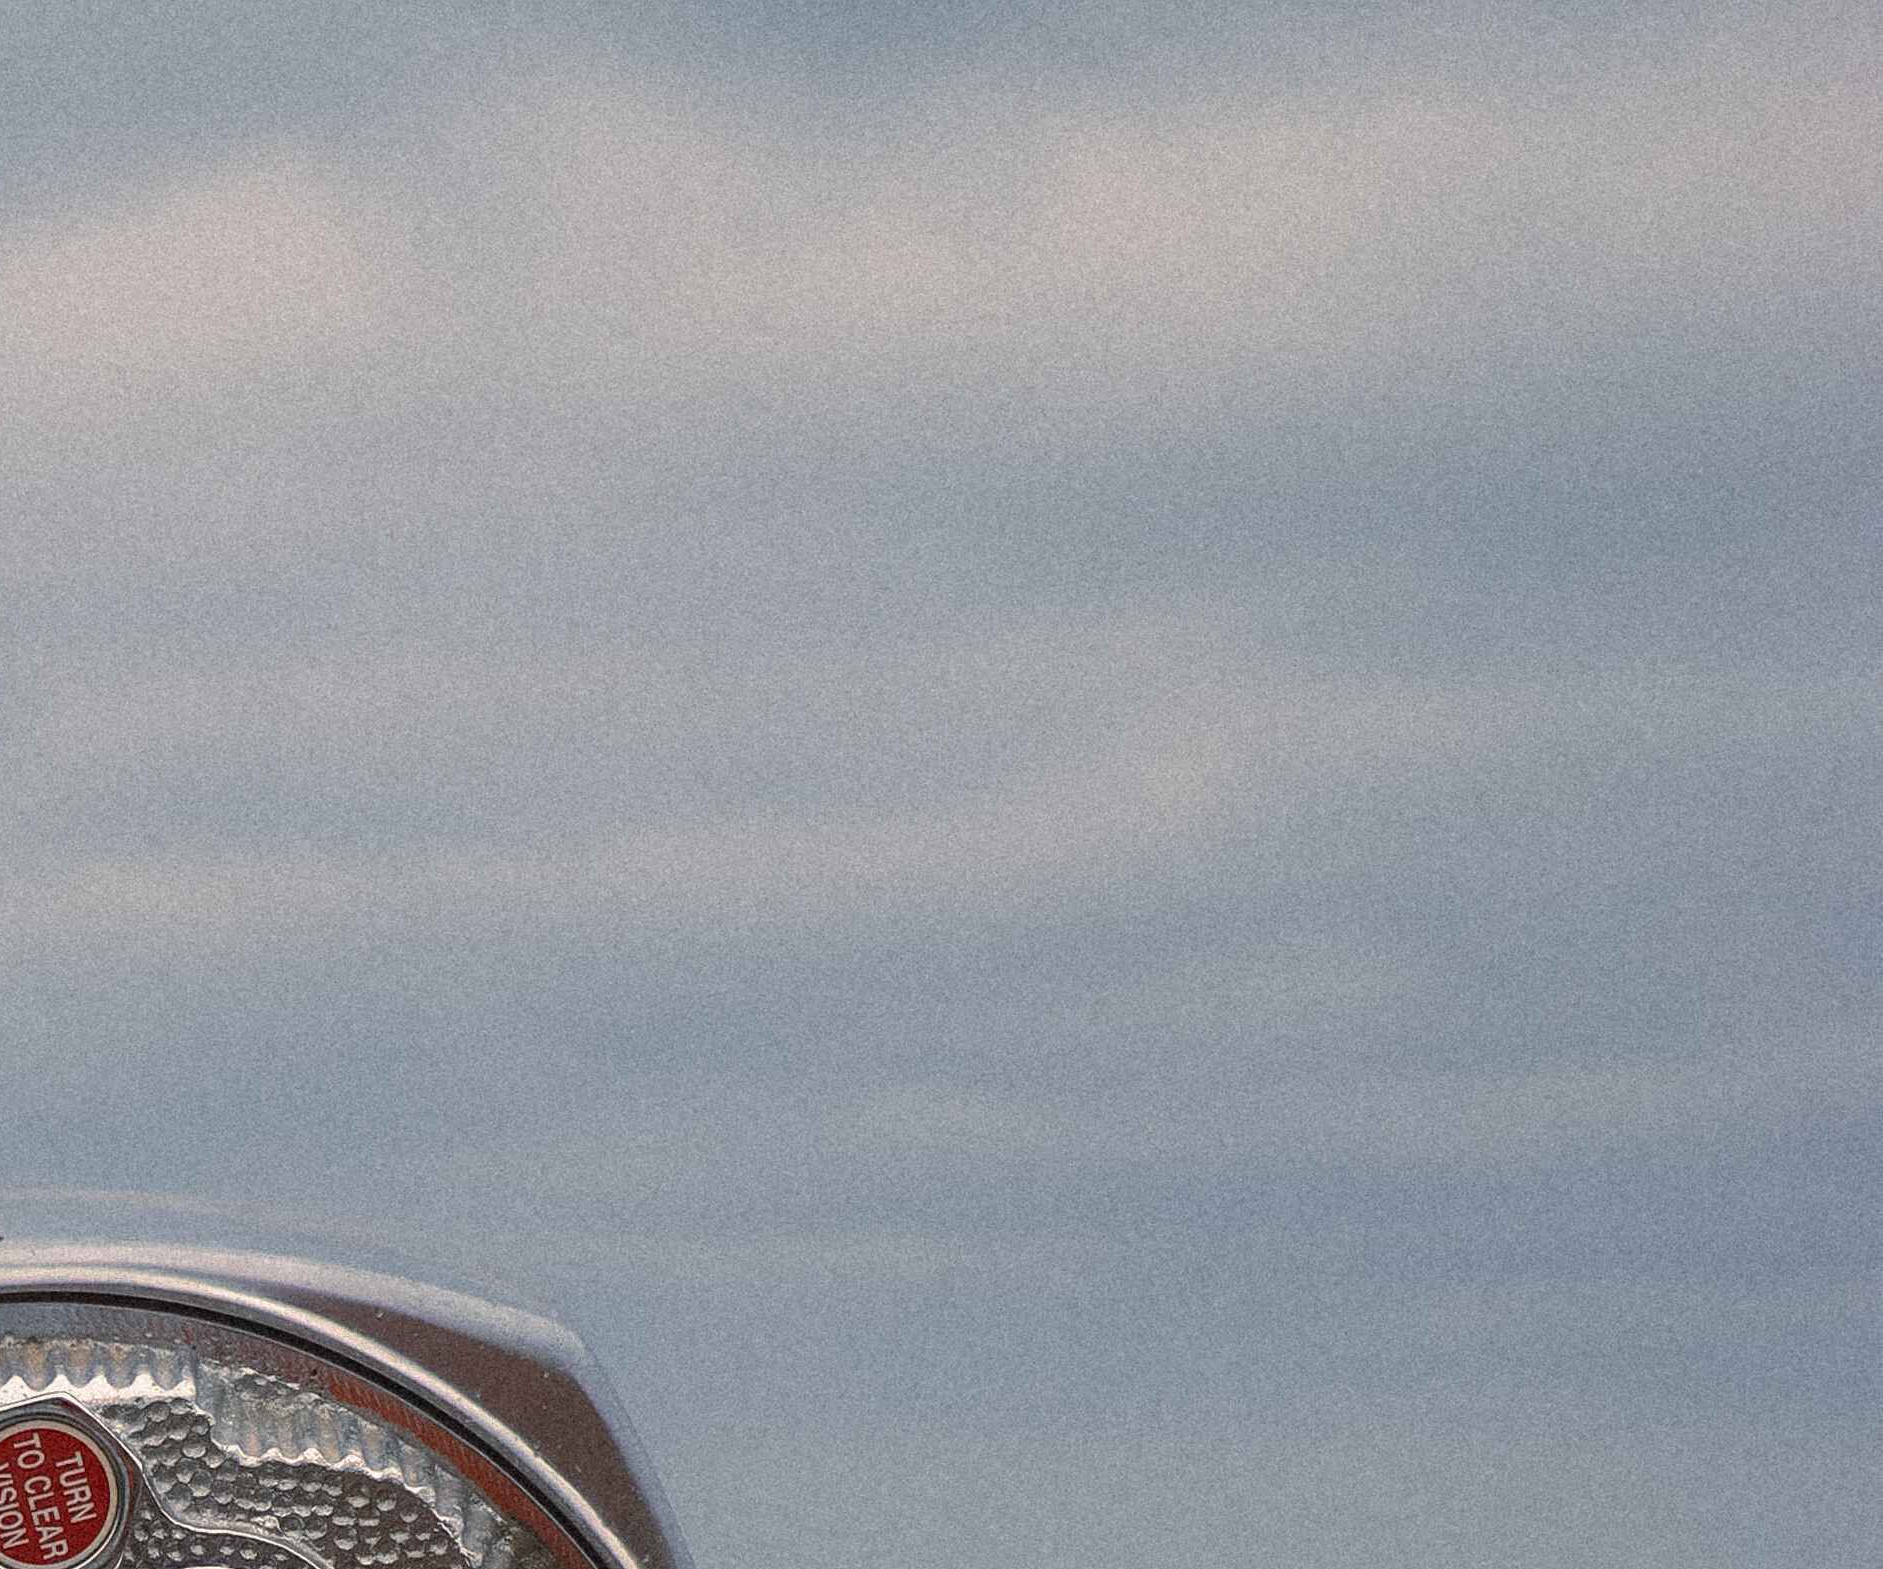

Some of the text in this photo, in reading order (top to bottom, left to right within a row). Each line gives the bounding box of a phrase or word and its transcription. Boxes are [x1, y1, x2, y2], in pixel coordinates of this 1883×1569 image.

[13, 1432, 69, 1560] TO CLEAR
[55, 1451, 98, 1524] TURN
